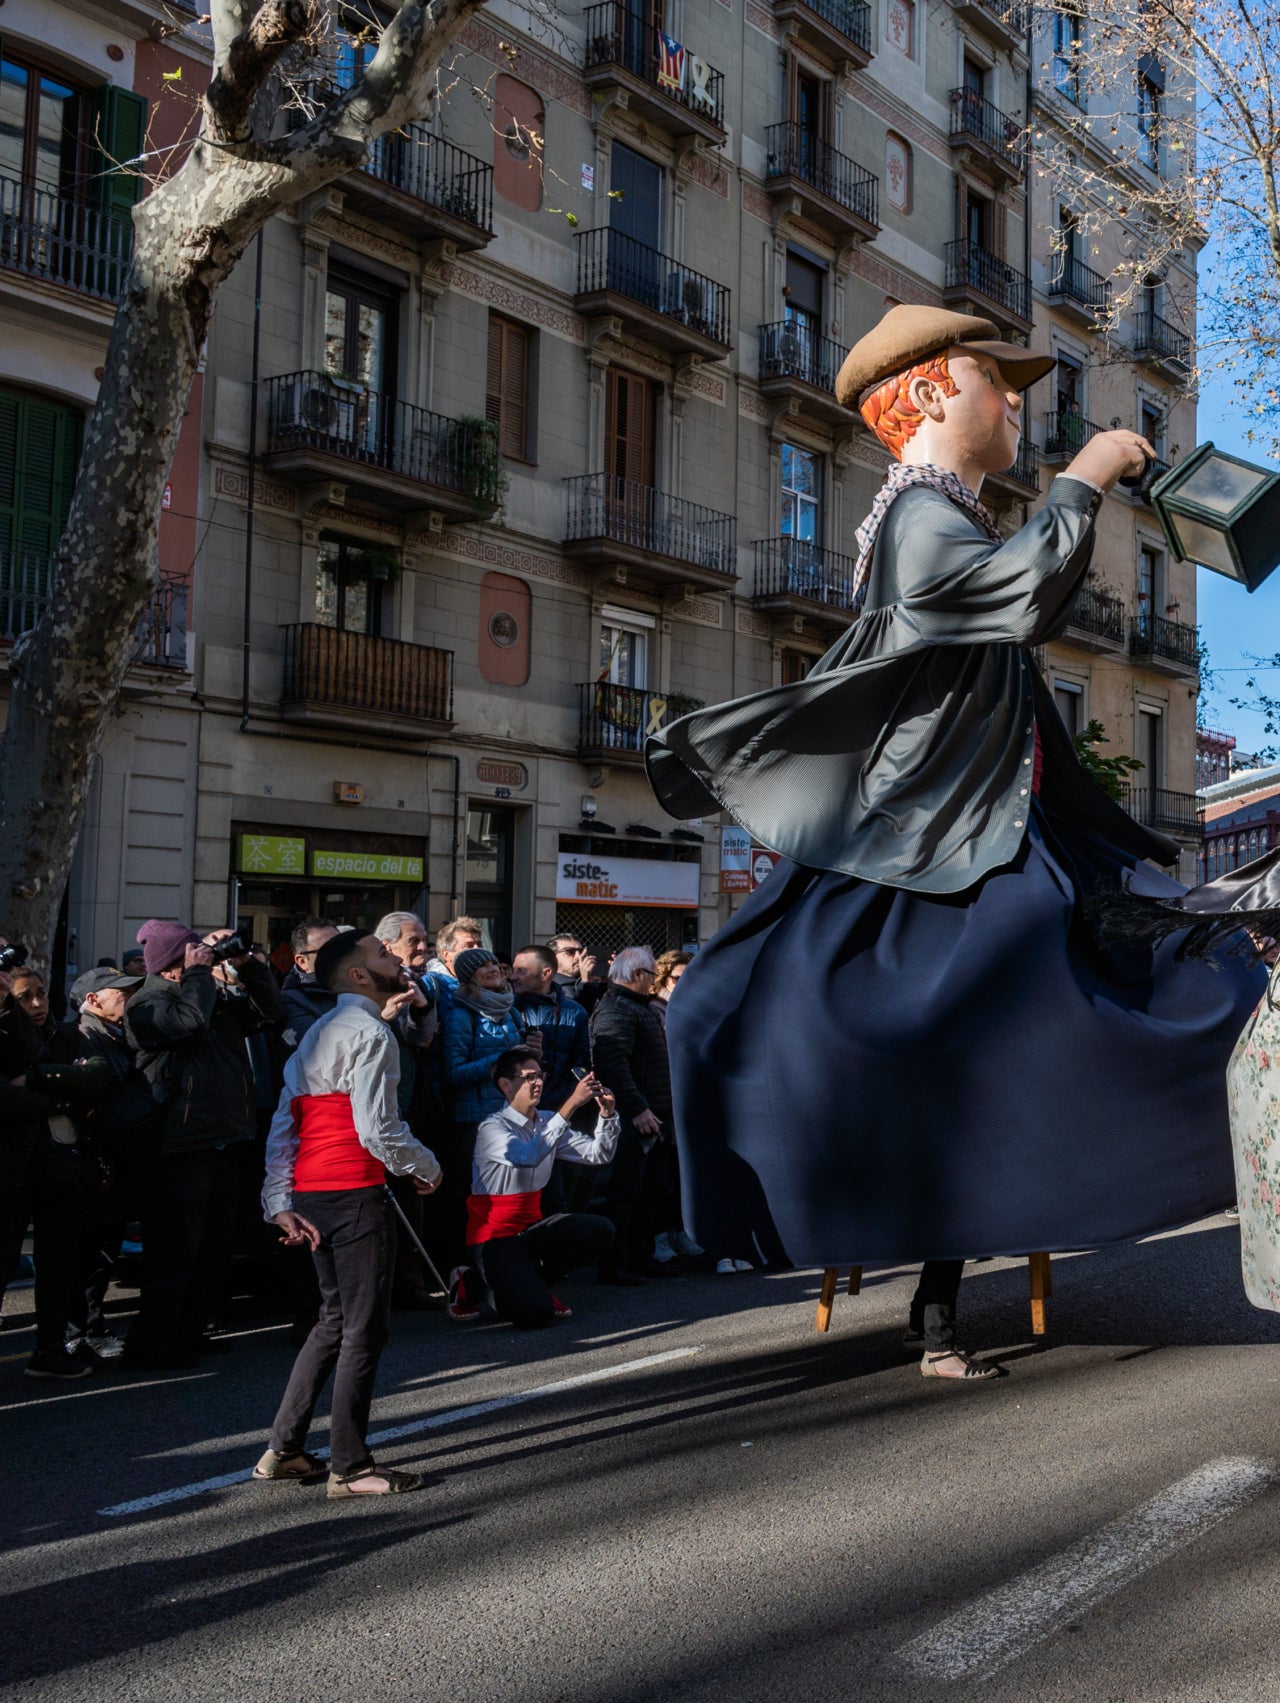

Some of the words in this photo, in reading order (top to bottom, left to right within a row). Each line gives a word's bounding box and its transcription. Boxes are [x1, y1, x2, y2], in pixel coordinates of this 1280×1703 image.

[723, 848, 748, 856] matic
[724, 837, 749, 848] siste-
[244, 837, 303, 872] 茶室
[316, 856, 377, 876] espacio
[380, 857, 402, 875] del
[407, 859, 420, 876] té
[563, 858, 609, 880] siste-
[576, 878, 618, 899] matic
